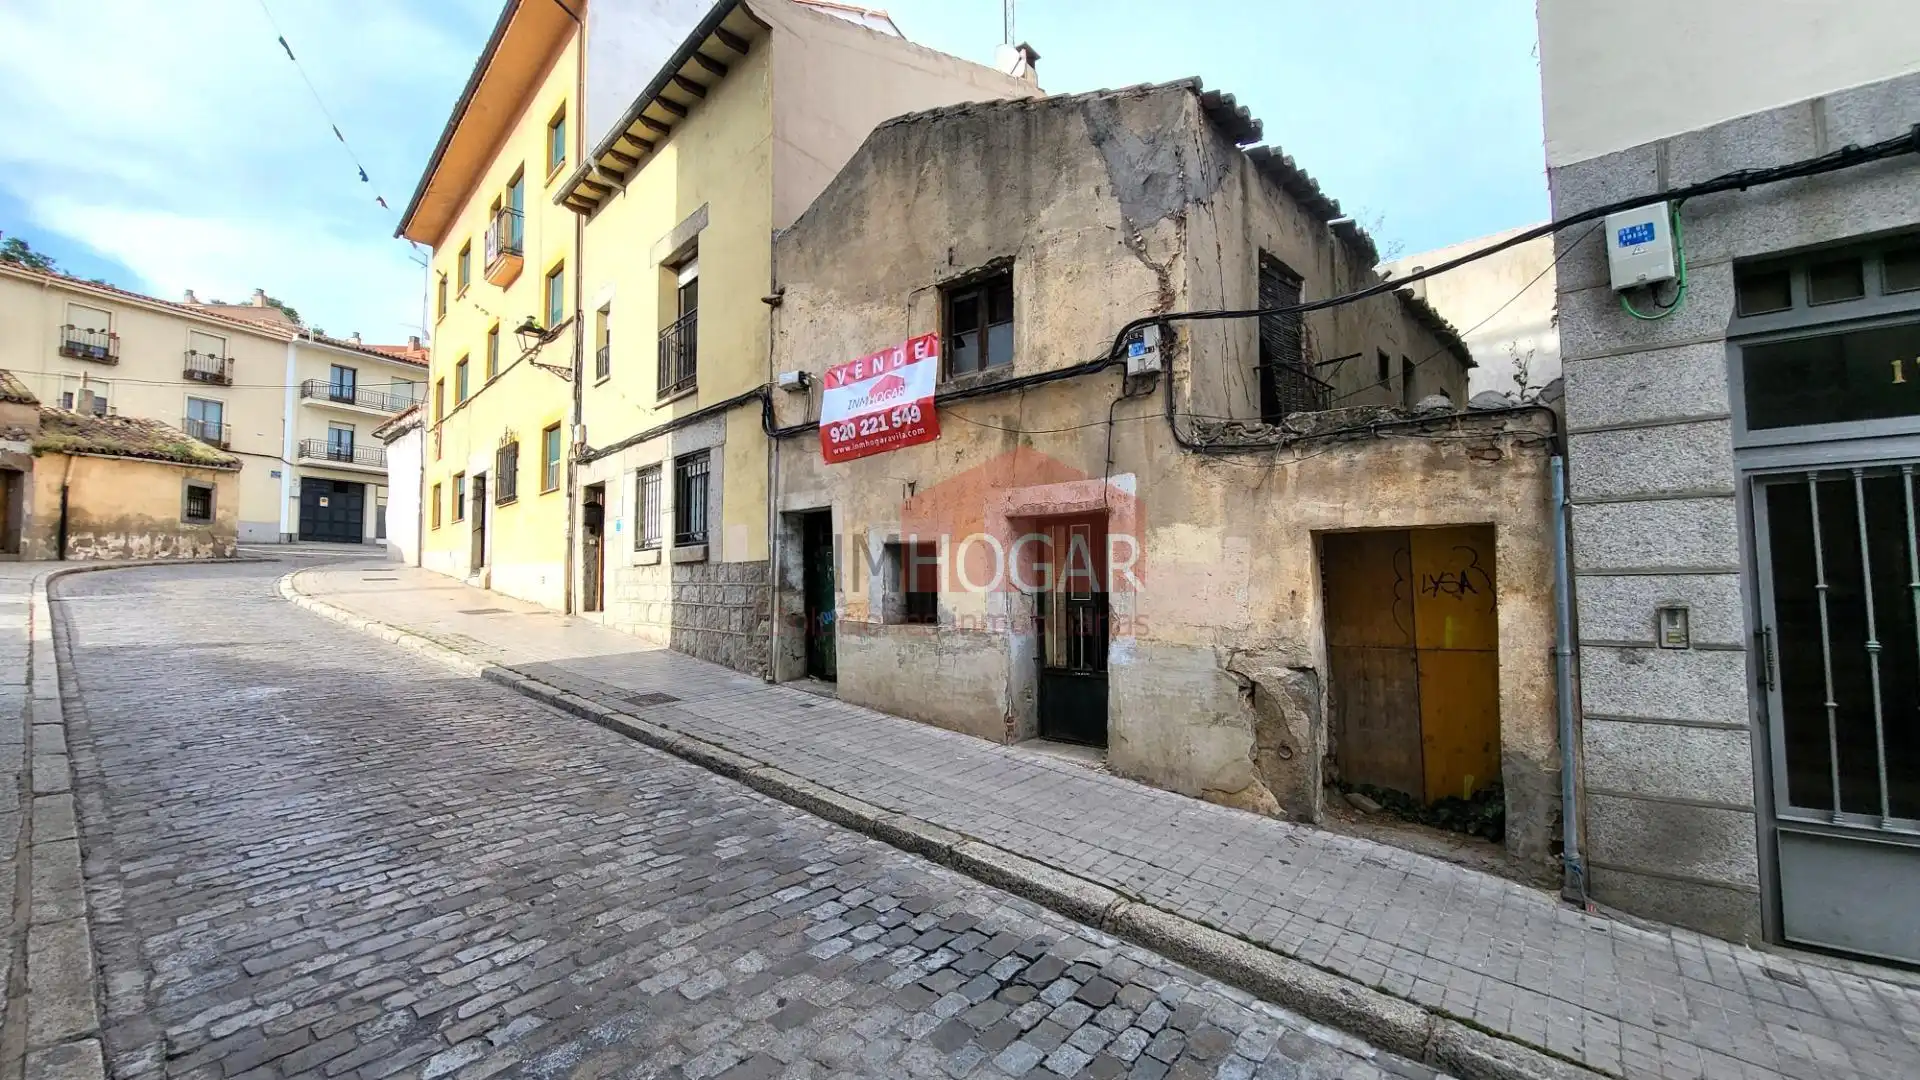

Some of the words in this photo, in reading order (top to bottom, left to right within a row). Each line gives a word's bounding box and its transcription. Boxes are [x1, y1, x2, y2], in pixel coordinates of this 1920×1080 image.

[836, 341, 926, 385] VENDE
[847, 385, 905, 411] INMHOGAR
[830, 422, 856, 444] 920
[860, 414, 889, 436] 221
[892, 404, 922, 429] 549
[833, 427, 926, 455] www.inmhogaravila.com
